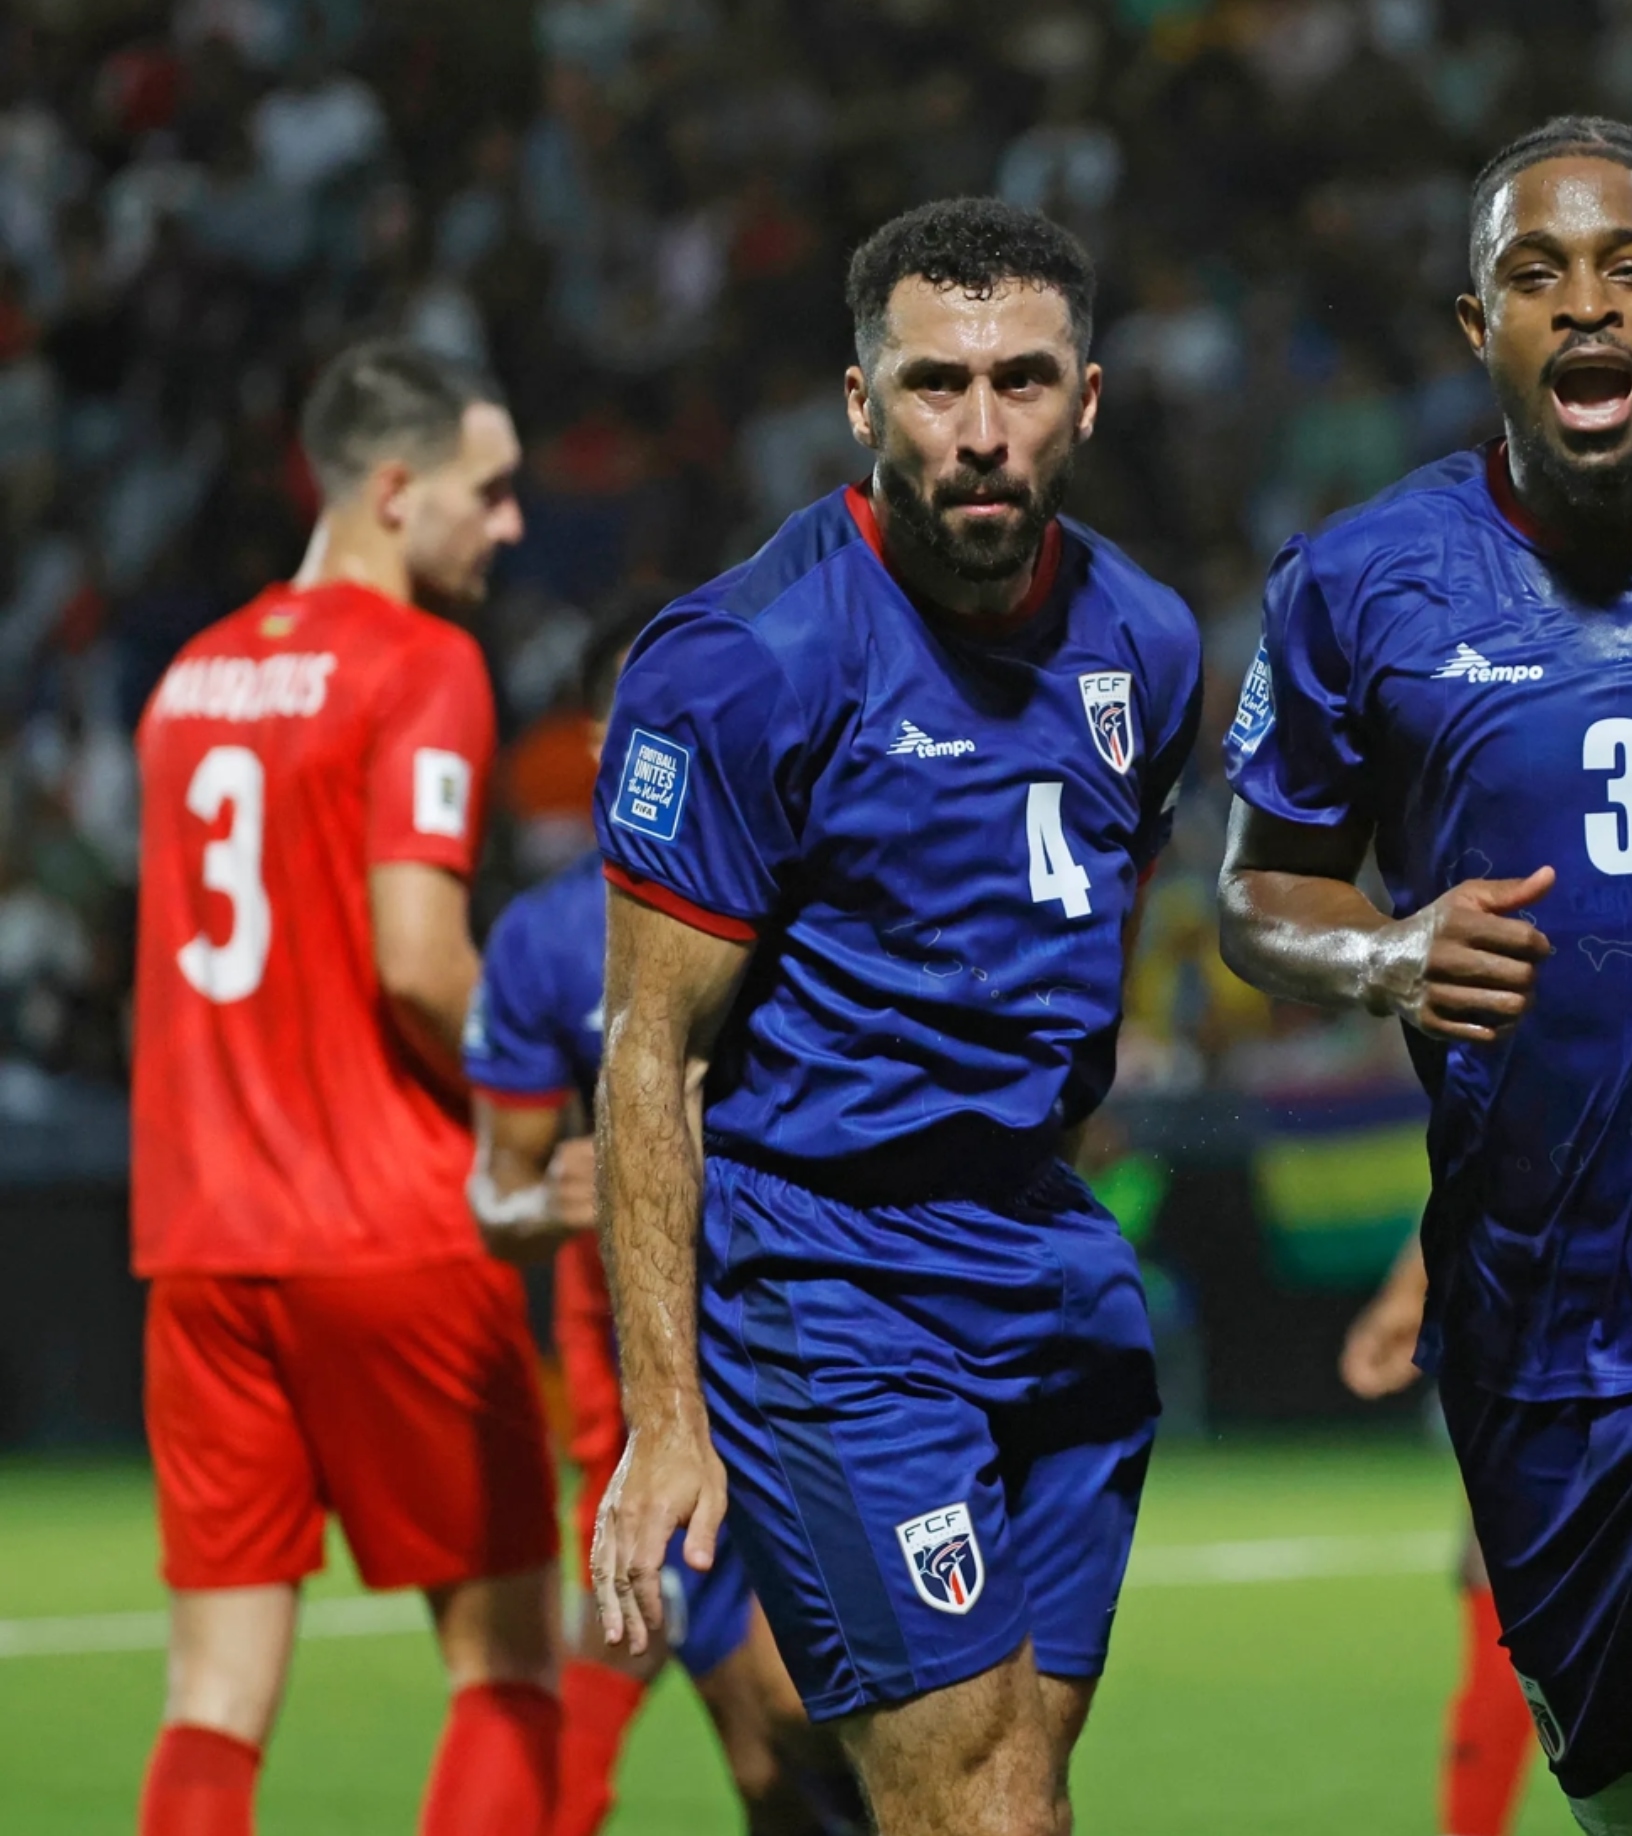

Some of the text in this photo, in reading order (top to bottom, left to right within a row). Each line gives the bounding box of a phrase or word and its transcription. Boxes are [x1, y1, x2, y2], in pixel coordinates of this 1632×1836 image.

[1083, 677, 1126, 695] FCF
[1467, 665, 1542, 684] tempo
[639, 745, 677, 772] FOOTBALL
[916, 739, 976, 758] tempo
[634, 758, 675, 790] UNITES
[641, 783, 674, 809] World
[634, 802, 653, 817] FIFA
[1026, 782, 1092, 919] 4
[177, 745, 271, 1004] 3
[904, 1510, 961, 1543] FCF
